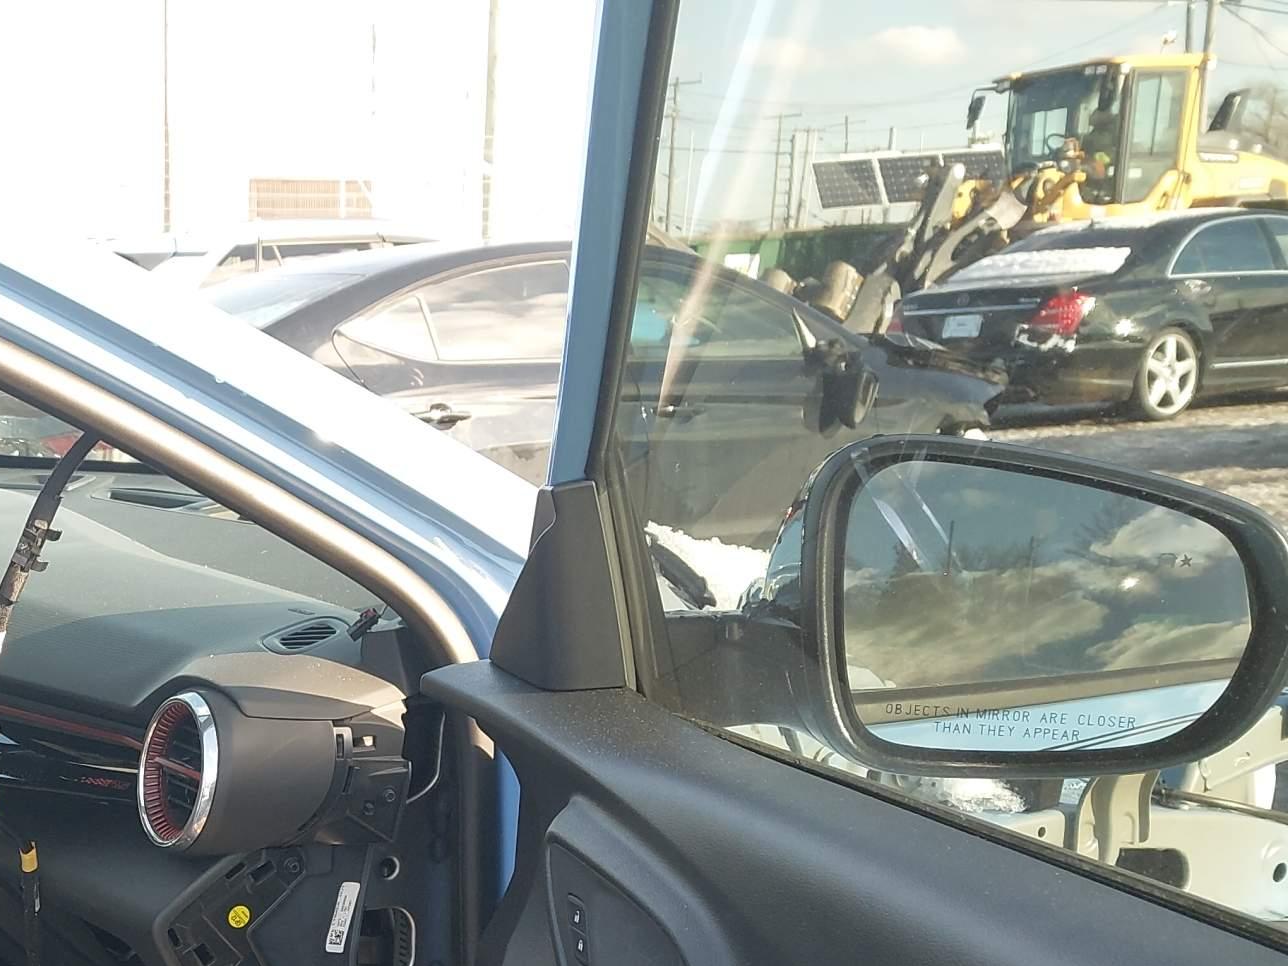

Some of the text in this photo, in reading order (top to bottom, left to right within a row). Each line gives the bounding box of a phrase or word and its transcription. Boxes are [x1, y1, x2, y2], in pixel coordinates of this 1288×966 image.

[885, 702, 1137, 730] OBJECTS IN MIRROR ARE CLOSER
[934, 720, 1081, 742] THAN THEY APPEAR
